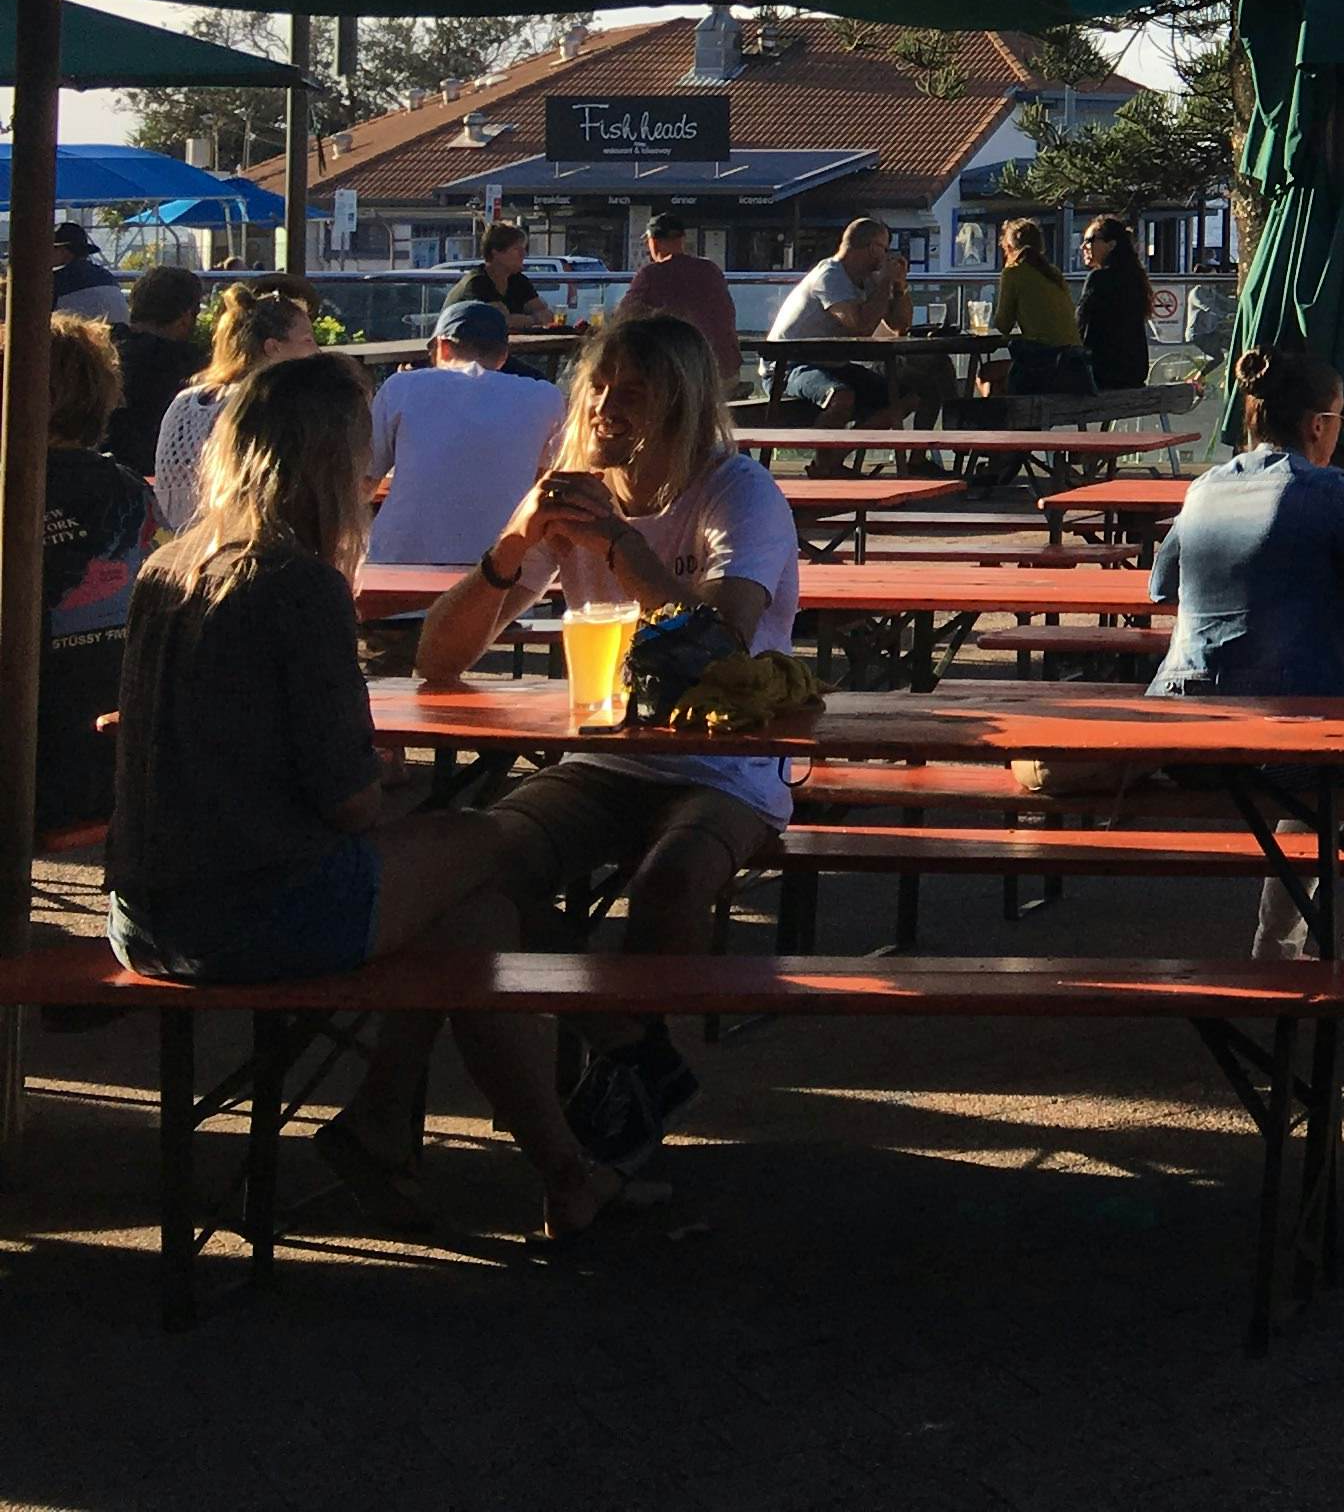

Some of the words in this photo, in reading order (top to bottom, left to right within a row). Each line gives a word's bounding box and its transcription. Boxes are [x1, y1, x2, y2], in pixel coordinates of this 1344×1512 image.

[572, 103, 637, 141] Fish
[640, 111, 698, 141] heads
[534, 195, 571, 205] breakfast
[608, 195, 630, 205] lunch
[671, 195, 697, 205] dinner
[46, 517, 80, 532] ORK
